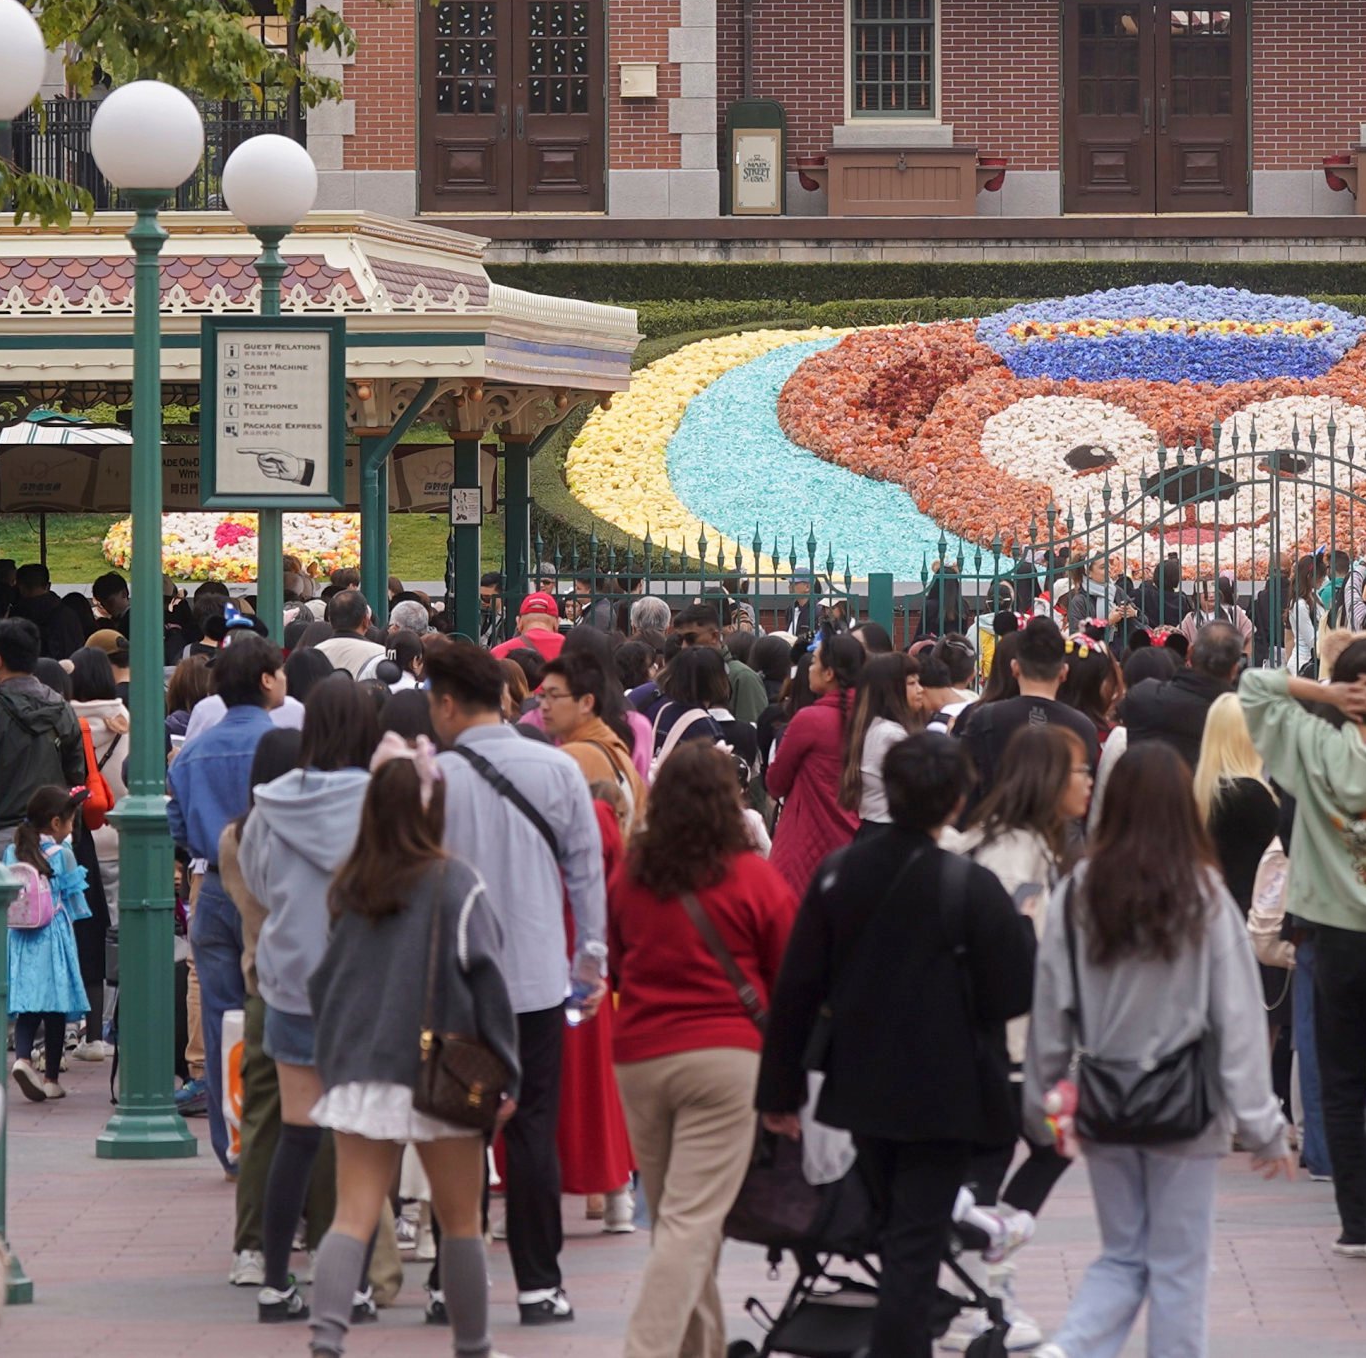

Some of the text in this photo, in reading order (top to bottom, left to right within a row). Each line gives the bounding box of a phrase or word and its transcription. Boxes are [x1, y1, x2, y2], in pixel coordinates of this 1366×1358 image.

[743, 167, 771, 180] STREET
[274, 343, 322, 351] RELATIONS
[269, 363, 309, 371] MACHINE
[243, 422, 323, 430] PACKAGE EXPRESS
